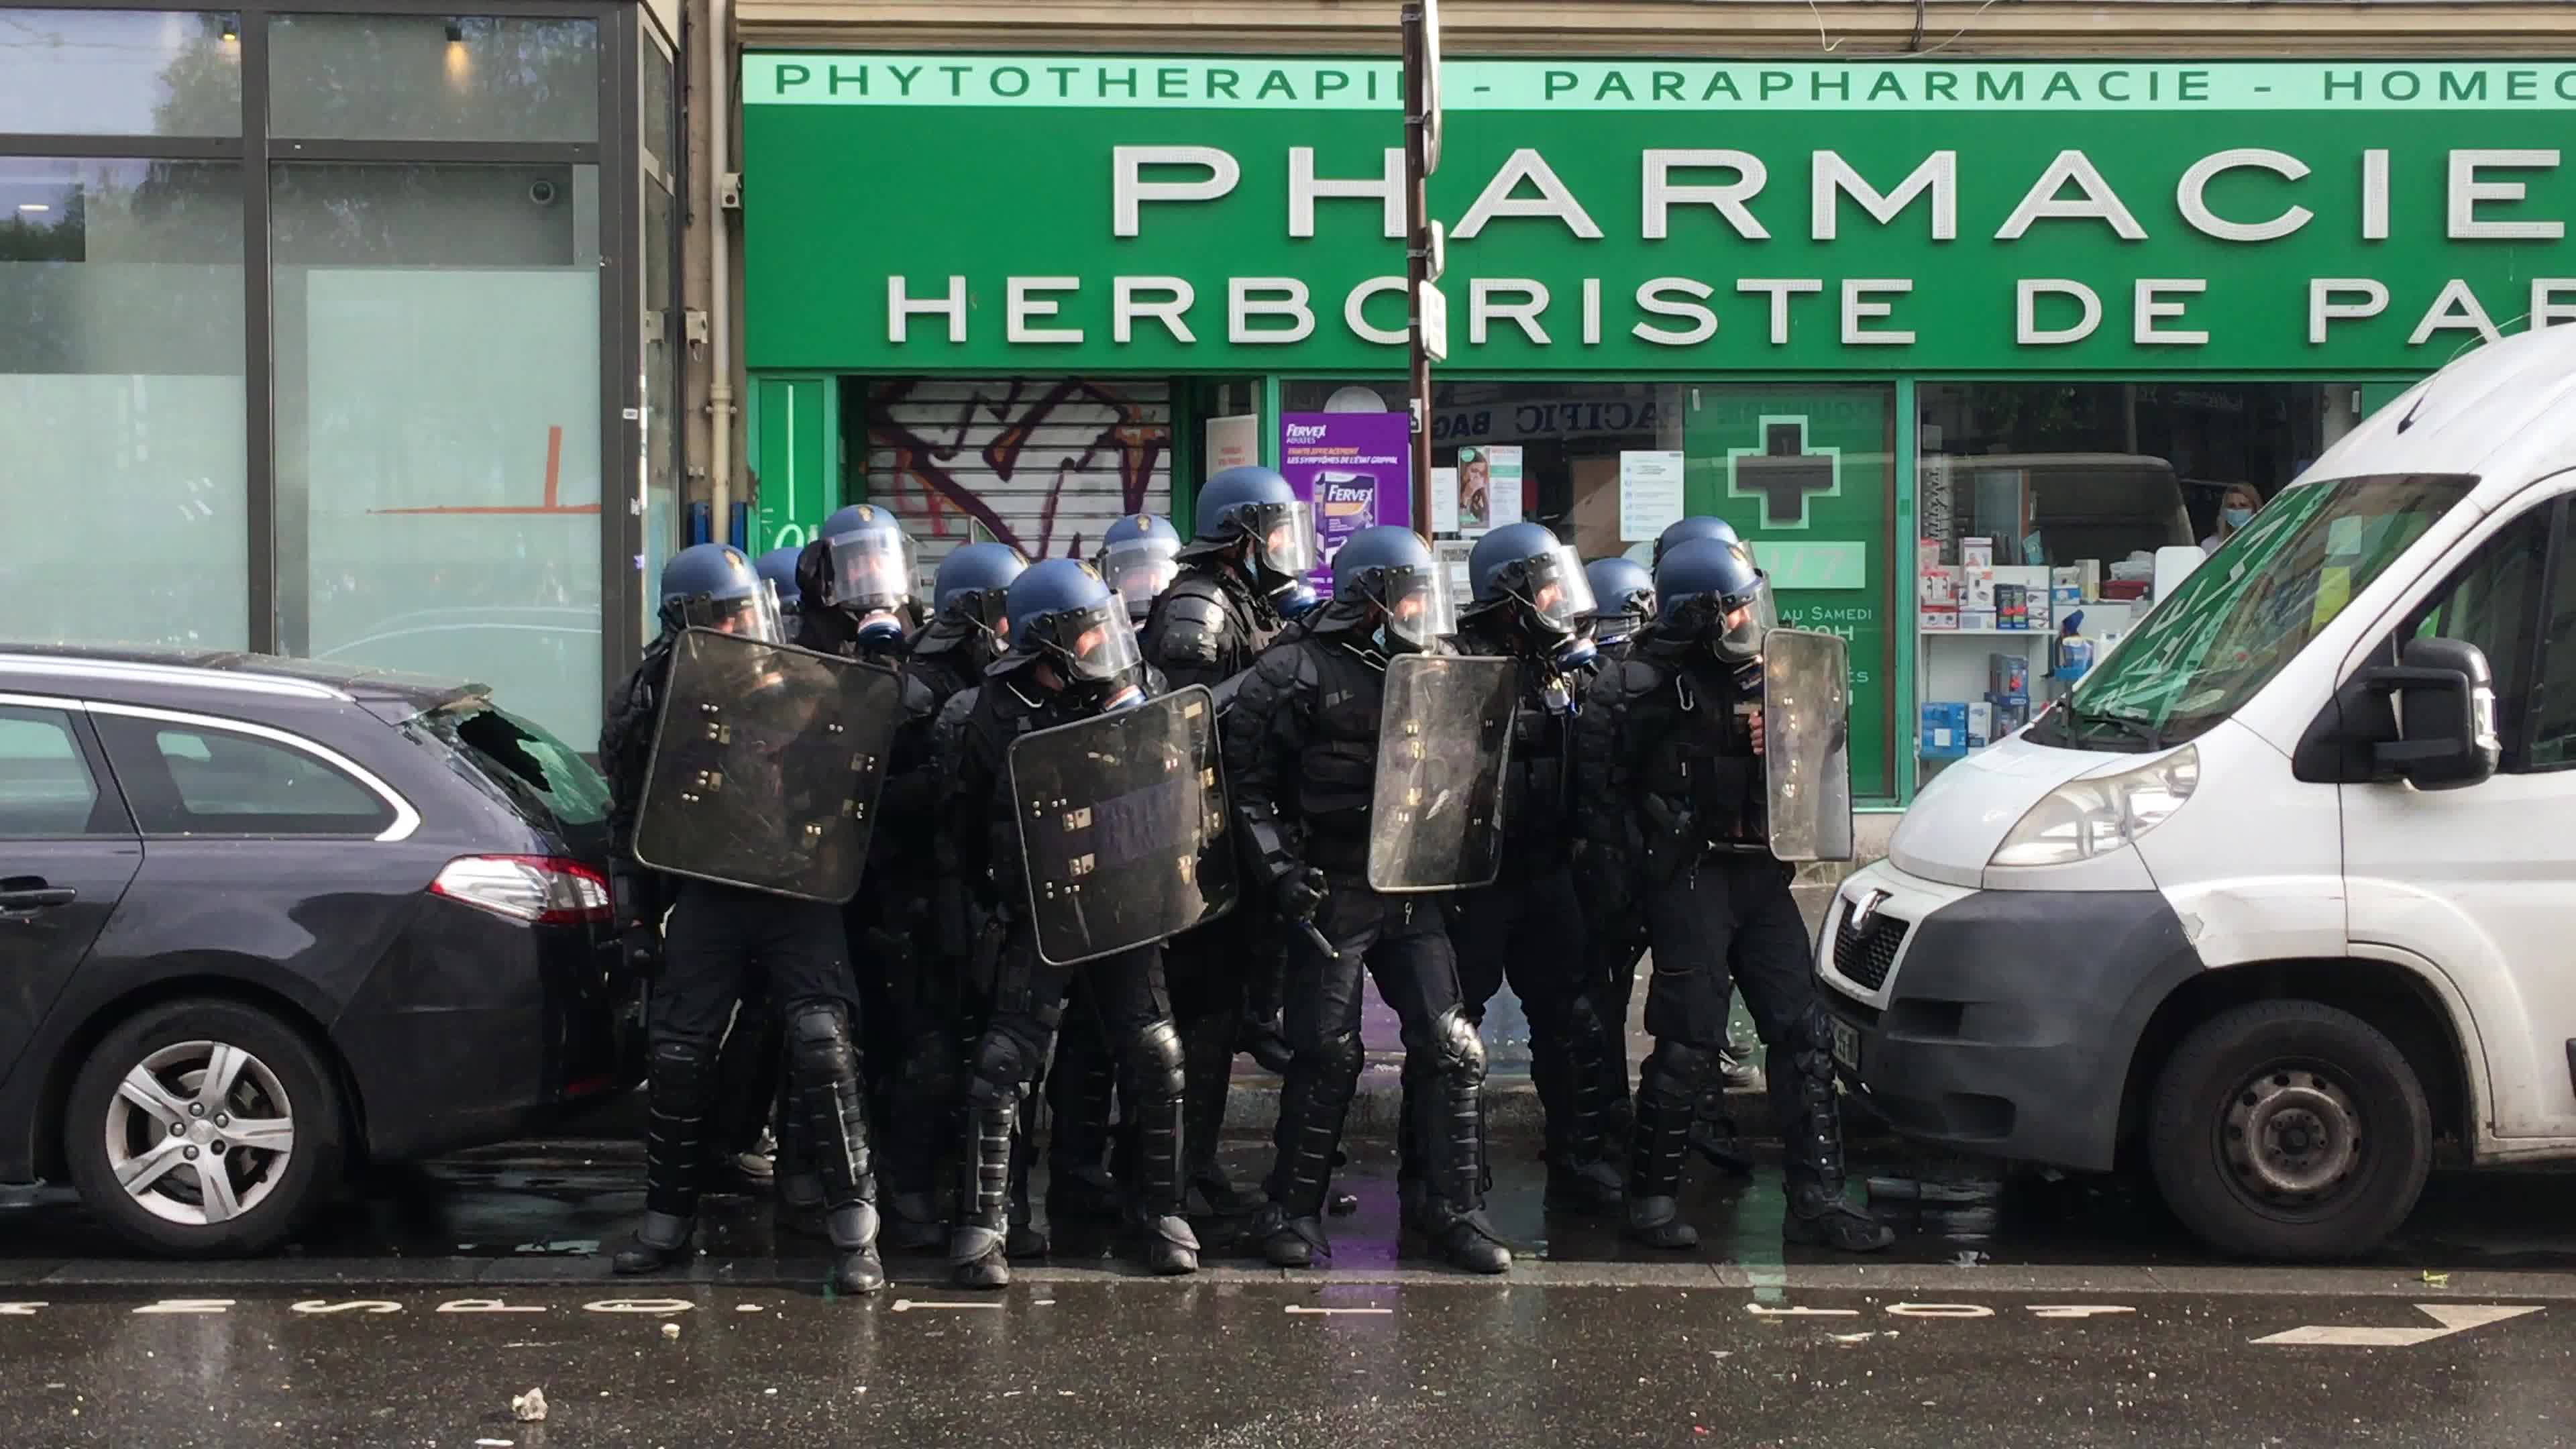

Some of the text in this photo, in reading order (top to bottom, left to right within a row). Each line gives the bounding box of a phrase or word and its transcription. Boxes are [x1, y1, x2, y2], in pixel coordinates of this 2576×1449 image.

[775, 64, 1403, 100] PHYTOTHERAPI
[1544, 70, 2209, 101] PARAPHARMACIE
[1113, 146, 2565, 241] PHARMACIE
[888, 276, 1916, 345] HERBORISTE
[2017, 278, 2209, 344] DE
[1328, 484, 1373, 502] FERVEX
